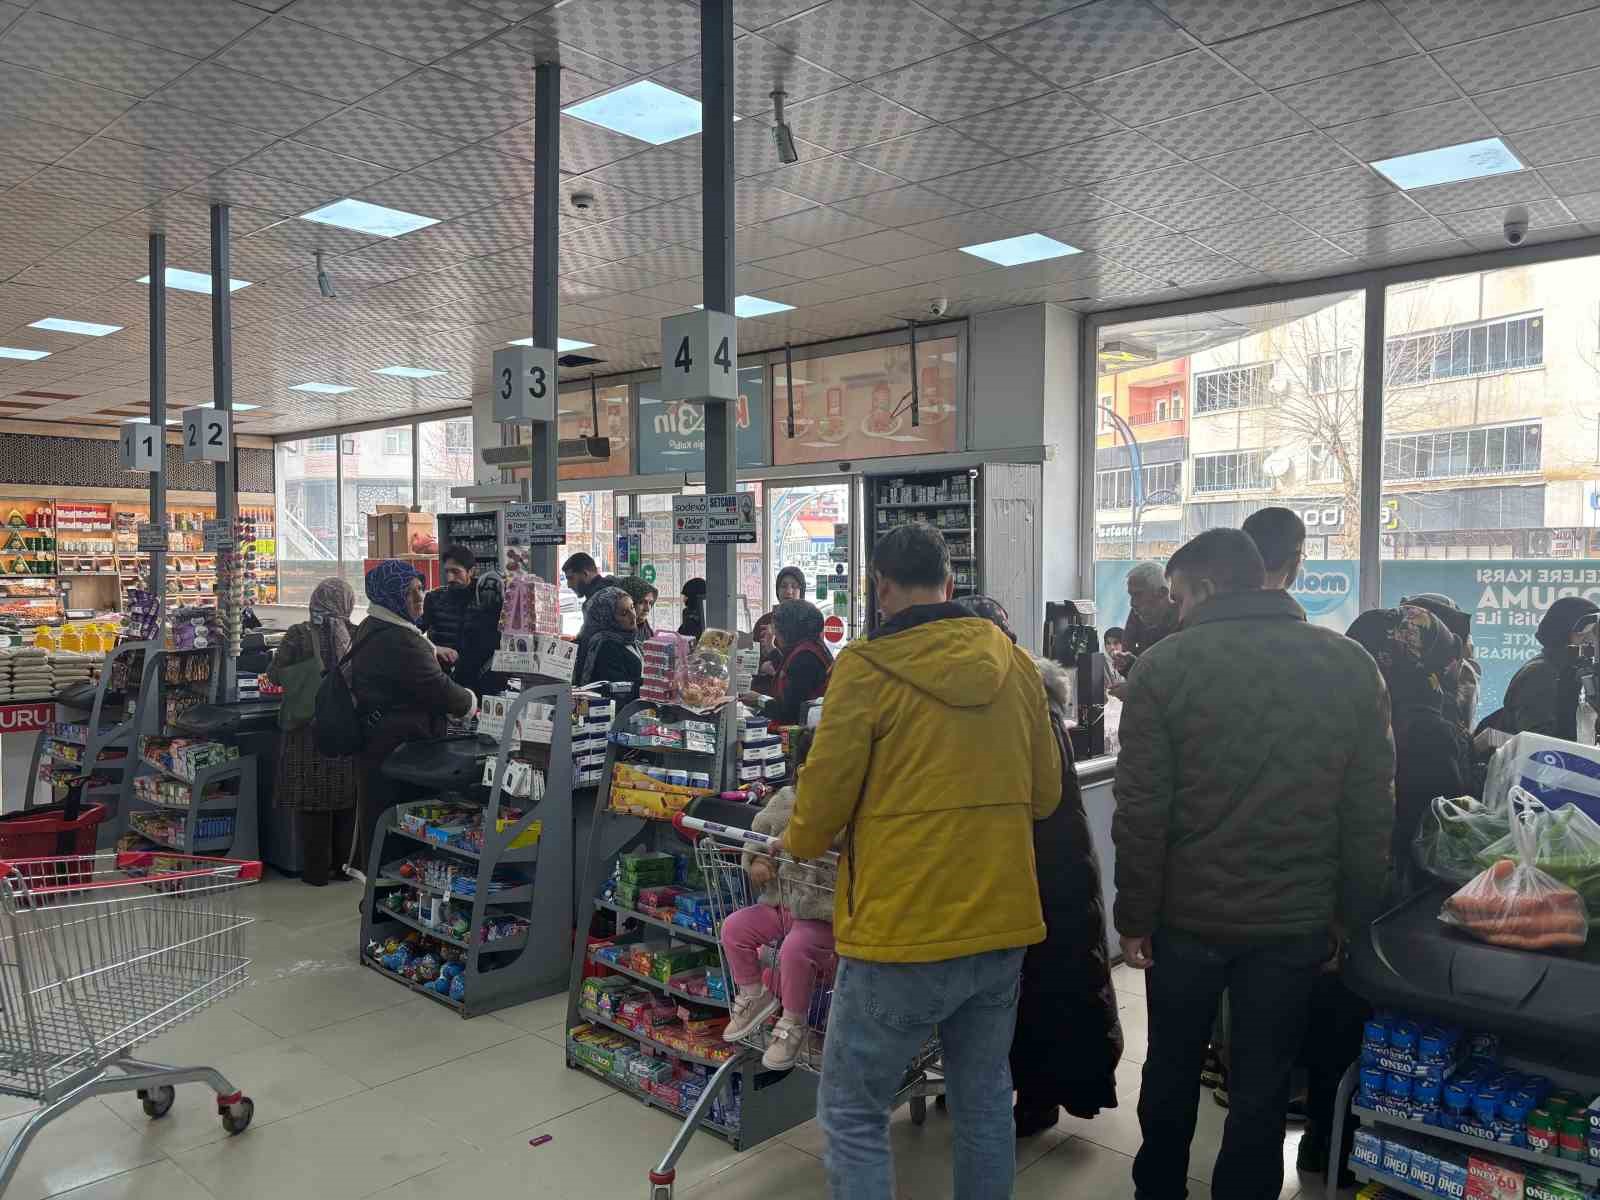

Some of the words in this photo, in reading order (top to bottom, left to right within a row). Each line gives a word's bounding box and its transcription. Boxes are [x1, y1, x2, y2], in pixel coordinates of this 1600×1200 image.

[674, 336, 693, 373] 4
[713, 336, 732, 374] 4
[501, 367, 512, 399] 3
[528, 366, 546, 399] 3
[188, 423, 197, 447] 2
[207, 422, 223, 446] 2
[142, 435, 153, 457] 1
[1380, 1057, 1412, 1073] ONEO
[1460, 1123, 1495, 1140] ONEO
[1355, 1146, 1378, 1164] ONEO
[1384, 1155, 1408, 1174] ONEO
[1411, 1167, 1436, 1186] ONEO
[1438, 1177, 1464, 1197] ONEO
